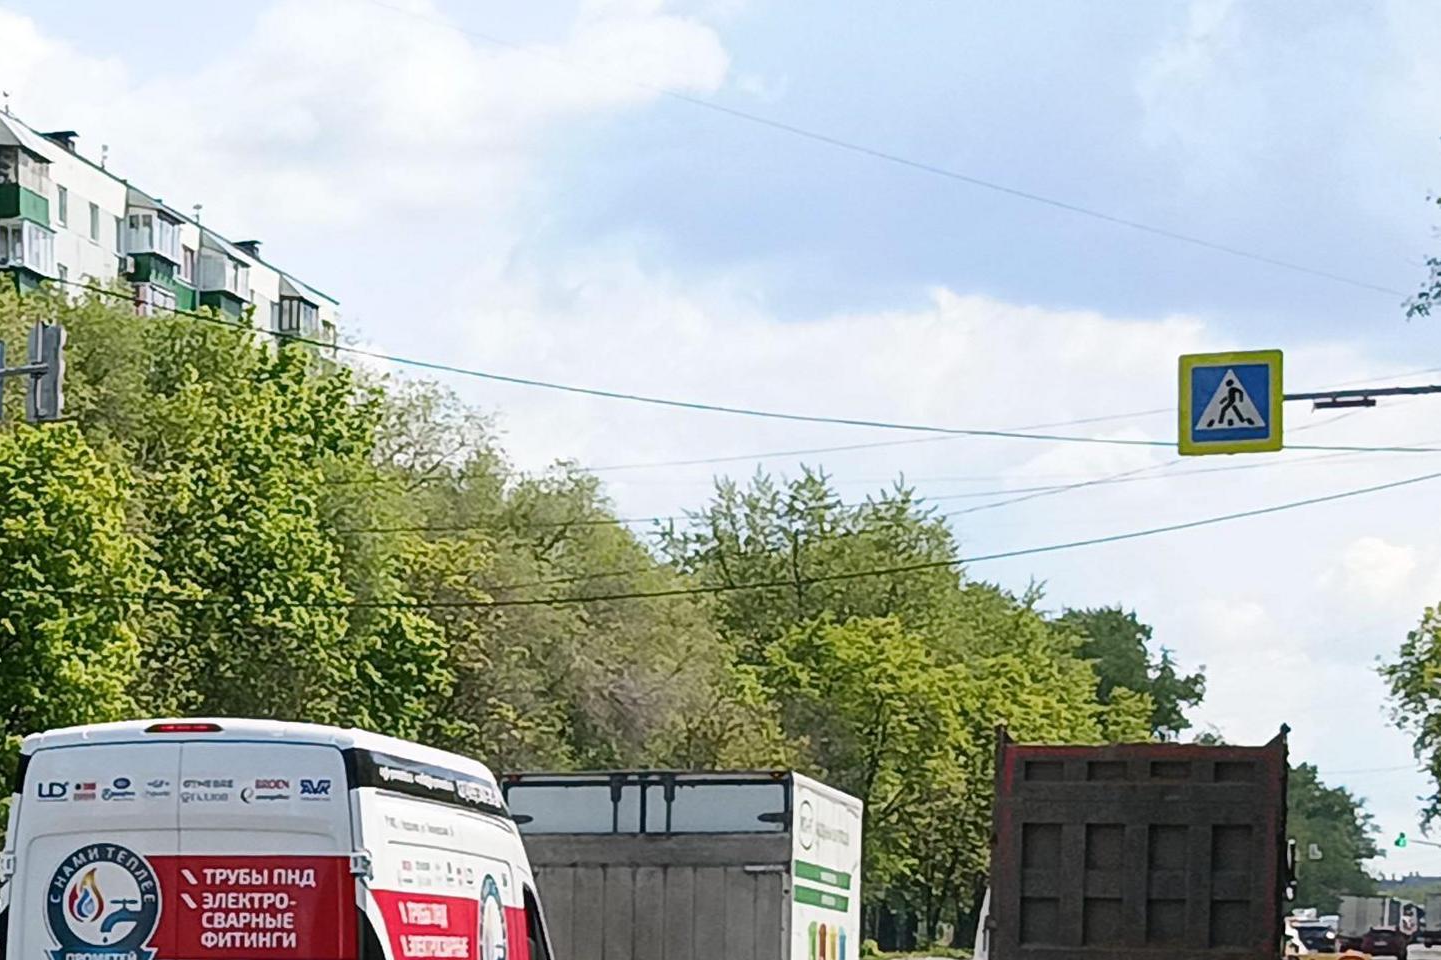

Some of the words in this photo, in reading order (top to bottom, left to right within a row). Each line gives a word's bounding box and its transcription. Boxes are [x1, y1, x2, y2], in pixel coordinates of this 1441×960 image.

[54, 847, 99, 888] НАМИ
[106, 847, 156, 902] ТЕПЛЕЕ
[203, 868, 268, 885] ТРУБЫ
[273, 869, 316, 888] ПНД
[202, 893, 297, 909] ЭЛЕКТРО-
[202, 912, 295, 928] СВАРНЫЕ
[201, 931, 297, 948] ФИТИНГИ
